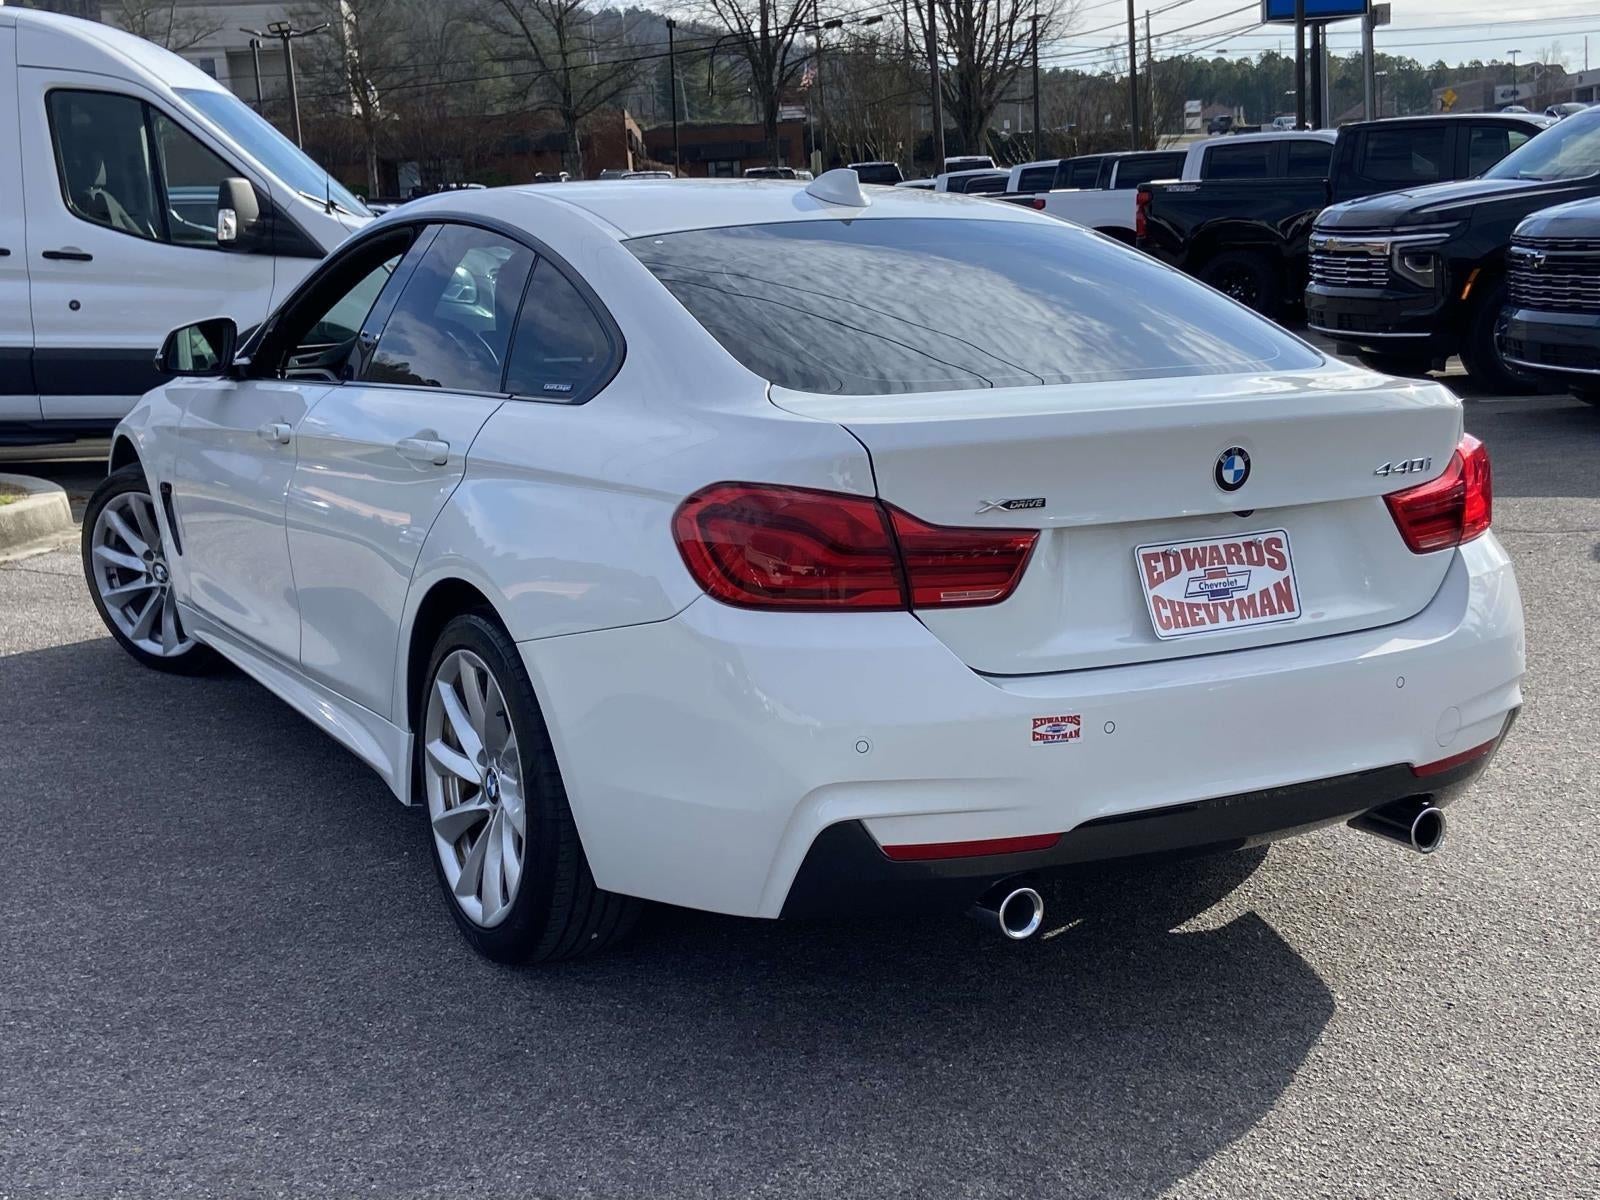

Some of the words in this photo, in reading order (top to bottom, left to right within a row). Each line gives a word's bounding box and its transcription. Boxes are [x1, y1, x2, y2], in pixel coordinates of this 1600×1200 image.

[1374, 456, 1432, 477] 440i
[1142, 537, 1288, 591] EDWARDS
[1198, 577, 1238, 590] Chevrolet
[1152, 575, 1296, 631] CHEVYMAN
[1032, 714, 1081, 730] EDWARDS
[1032, 727, 1081, 742] CHEVYMAN
